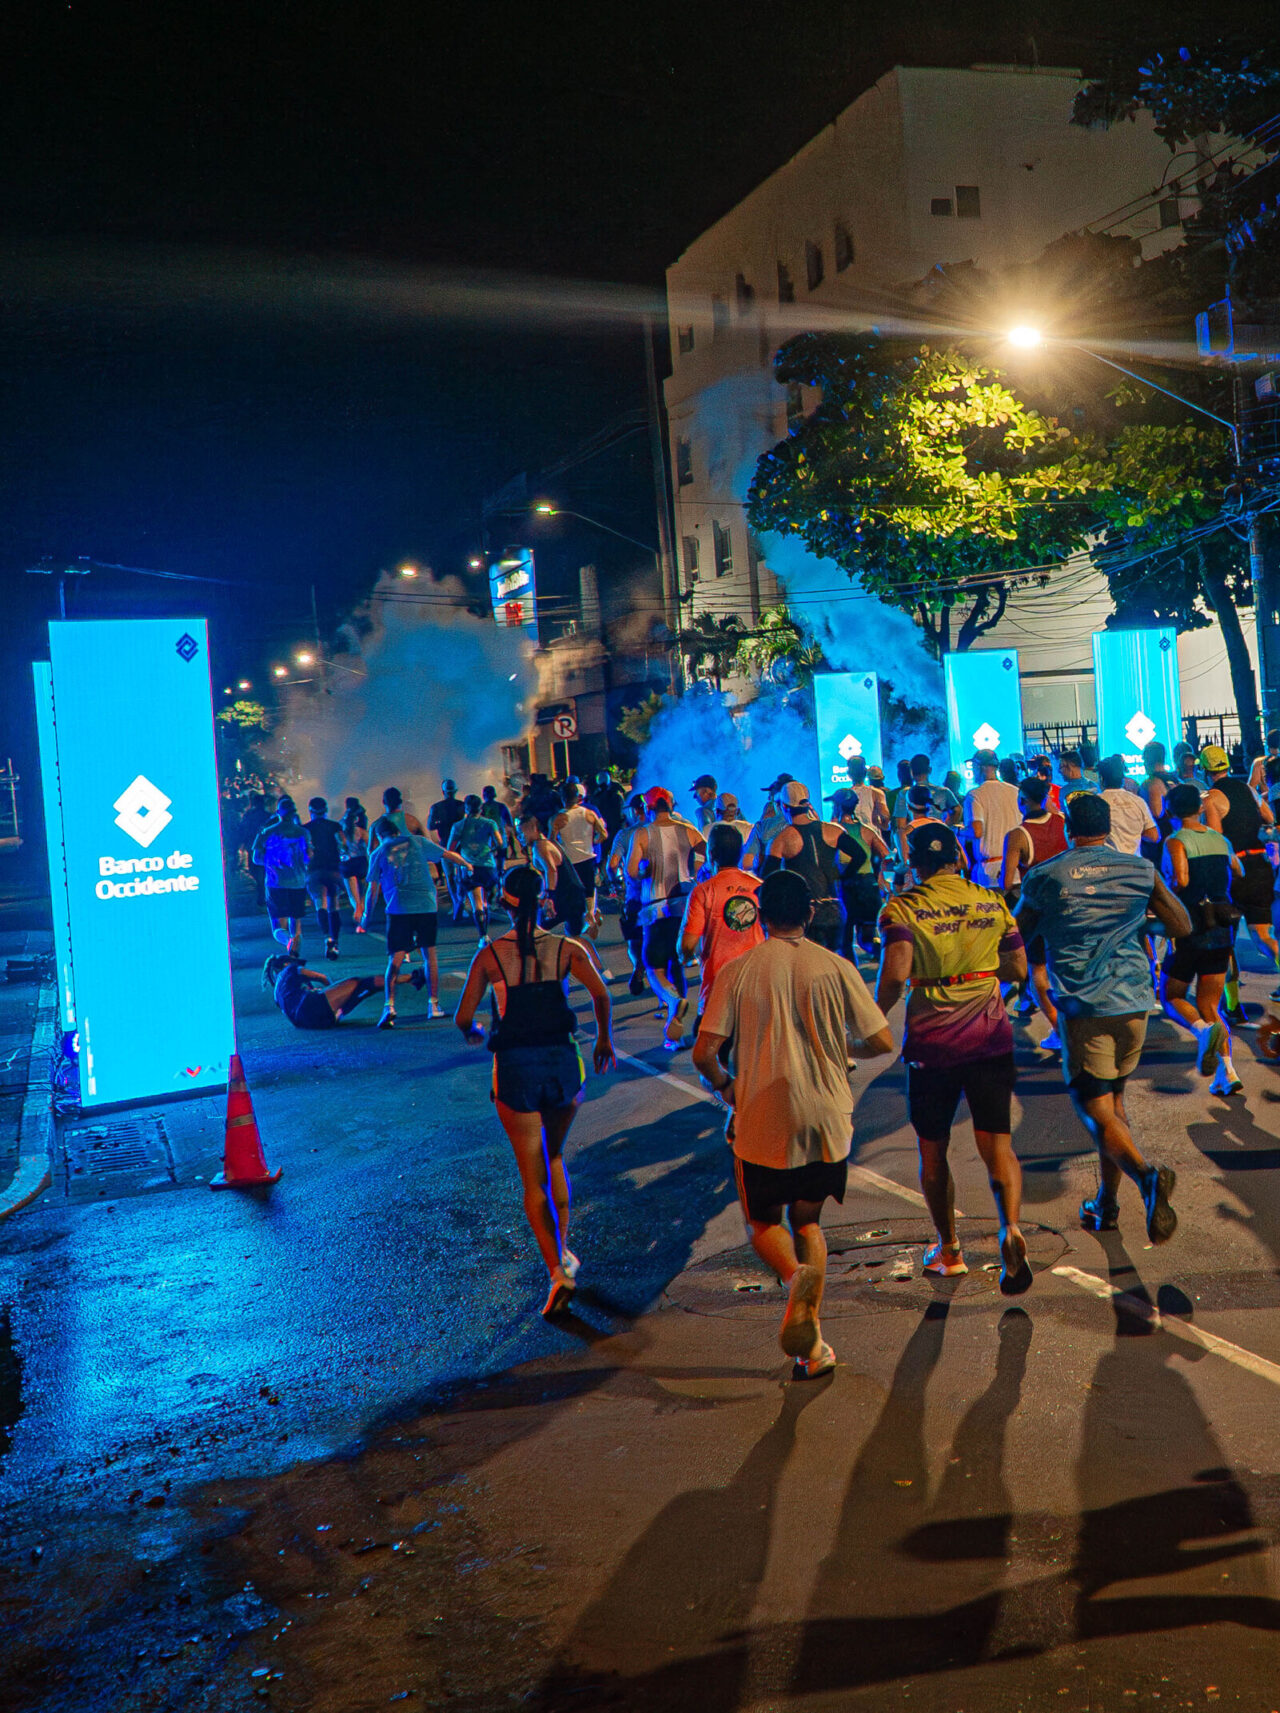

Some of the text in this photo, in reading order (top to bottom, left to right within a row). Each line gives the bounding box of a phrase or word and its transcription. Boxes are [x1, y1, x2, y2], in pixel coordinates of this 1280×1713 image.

[98, 850, 193, 876] Banco de
[95, 874, 200, 900] Occidente
